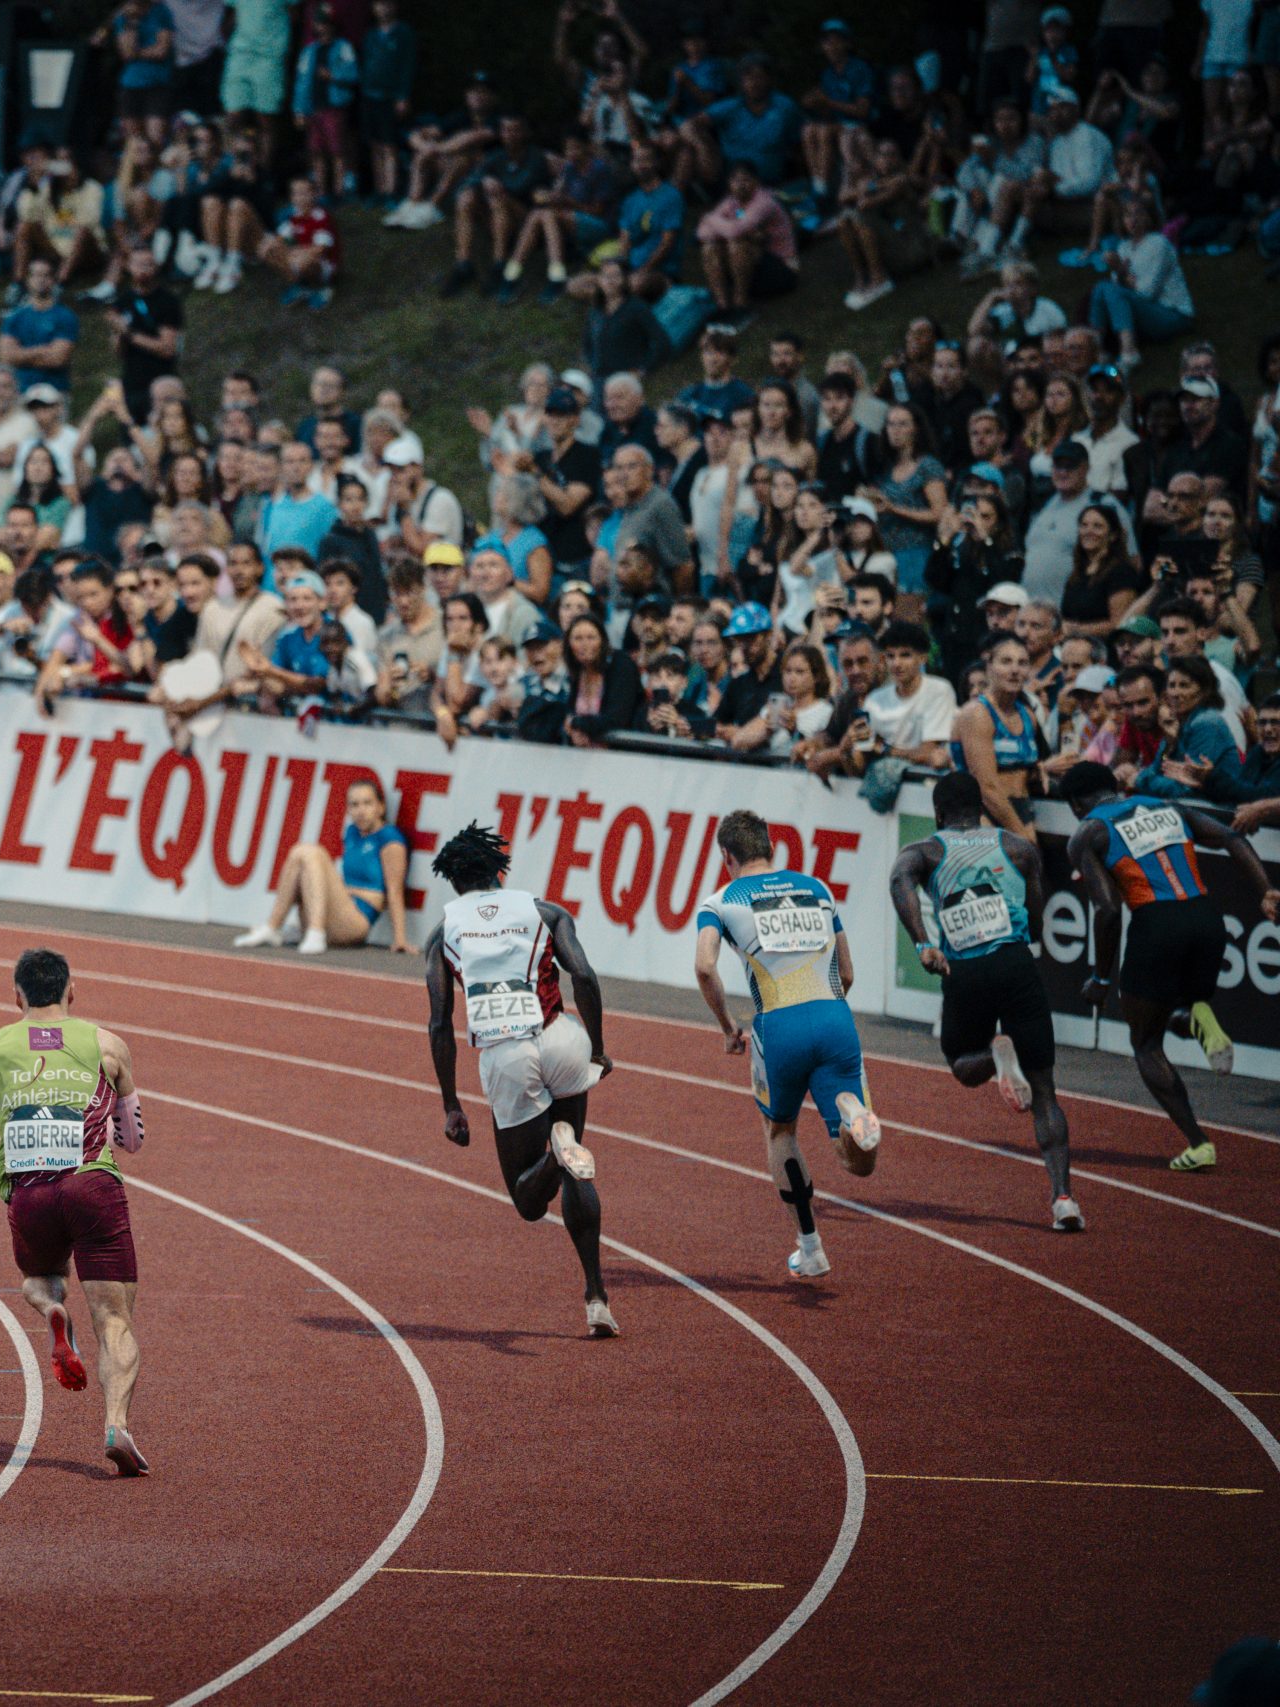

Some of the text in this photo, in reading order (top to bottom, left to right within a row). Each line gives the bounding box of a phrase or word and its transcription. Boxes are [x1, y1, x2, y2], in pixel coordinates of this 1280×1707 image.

[1122, 811, 1179, 842] BADRU
[759, 910, 823, 936] SCHAUB
[943, 898, 1005, 934] LERANDY
[472, 995, 537, 1023] ZEZE
[10, 1056, 93, 1086] Talence
[1, 1087, 102, 1111] Athlétisme
[7, 1124, 81, 1151] REBIERRE
[46, 1157, 78, 1167] Mutuel
